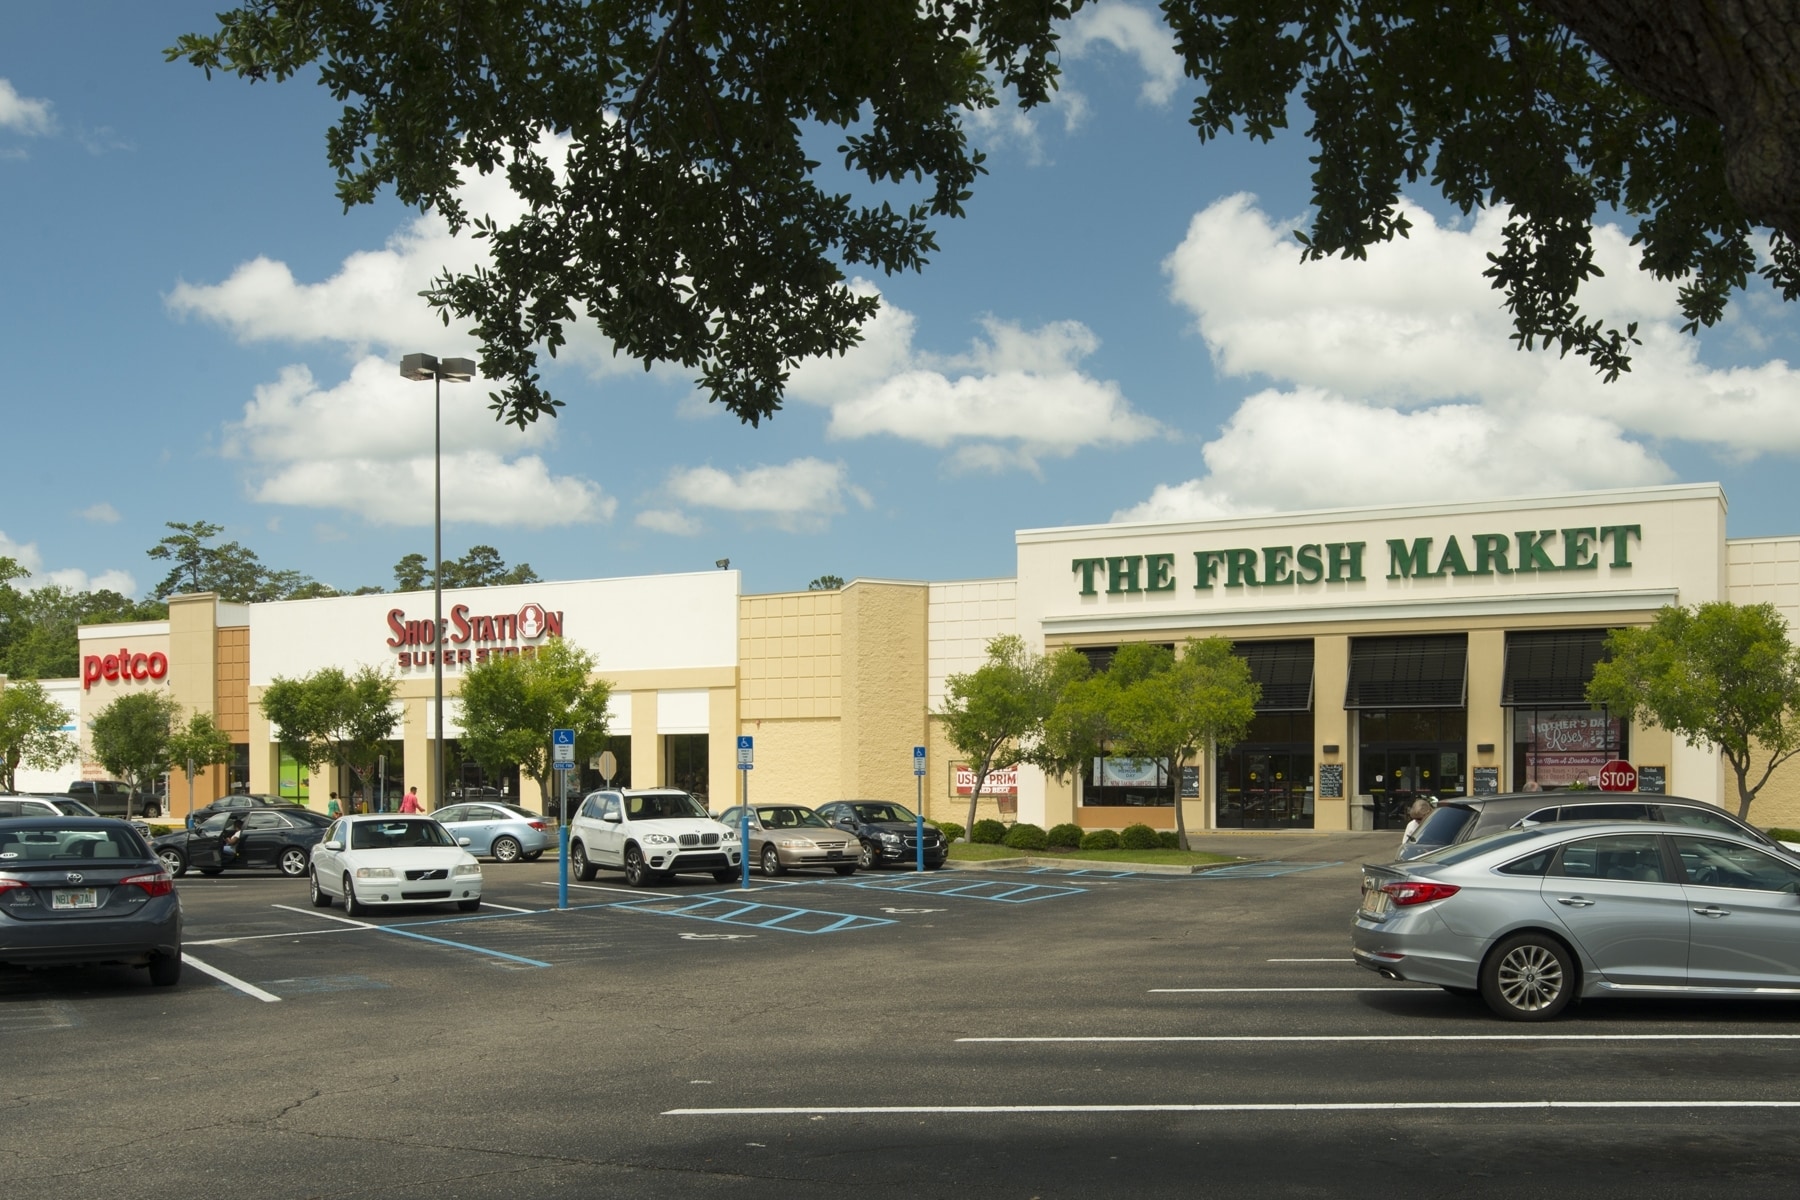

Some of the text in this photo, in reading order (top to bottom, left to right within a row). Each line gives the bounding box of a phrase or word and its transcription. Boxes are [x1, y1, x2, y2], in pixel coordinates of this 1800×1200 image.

[1072, 524, 1642, 596] THE FRESH MARKET
[386, 608, 449, 648] SHOE
[83, 648, 168, 690] petco
[1545, 728, 1583, 751] Roses
[1601, 771, 1635, 787] STOP
